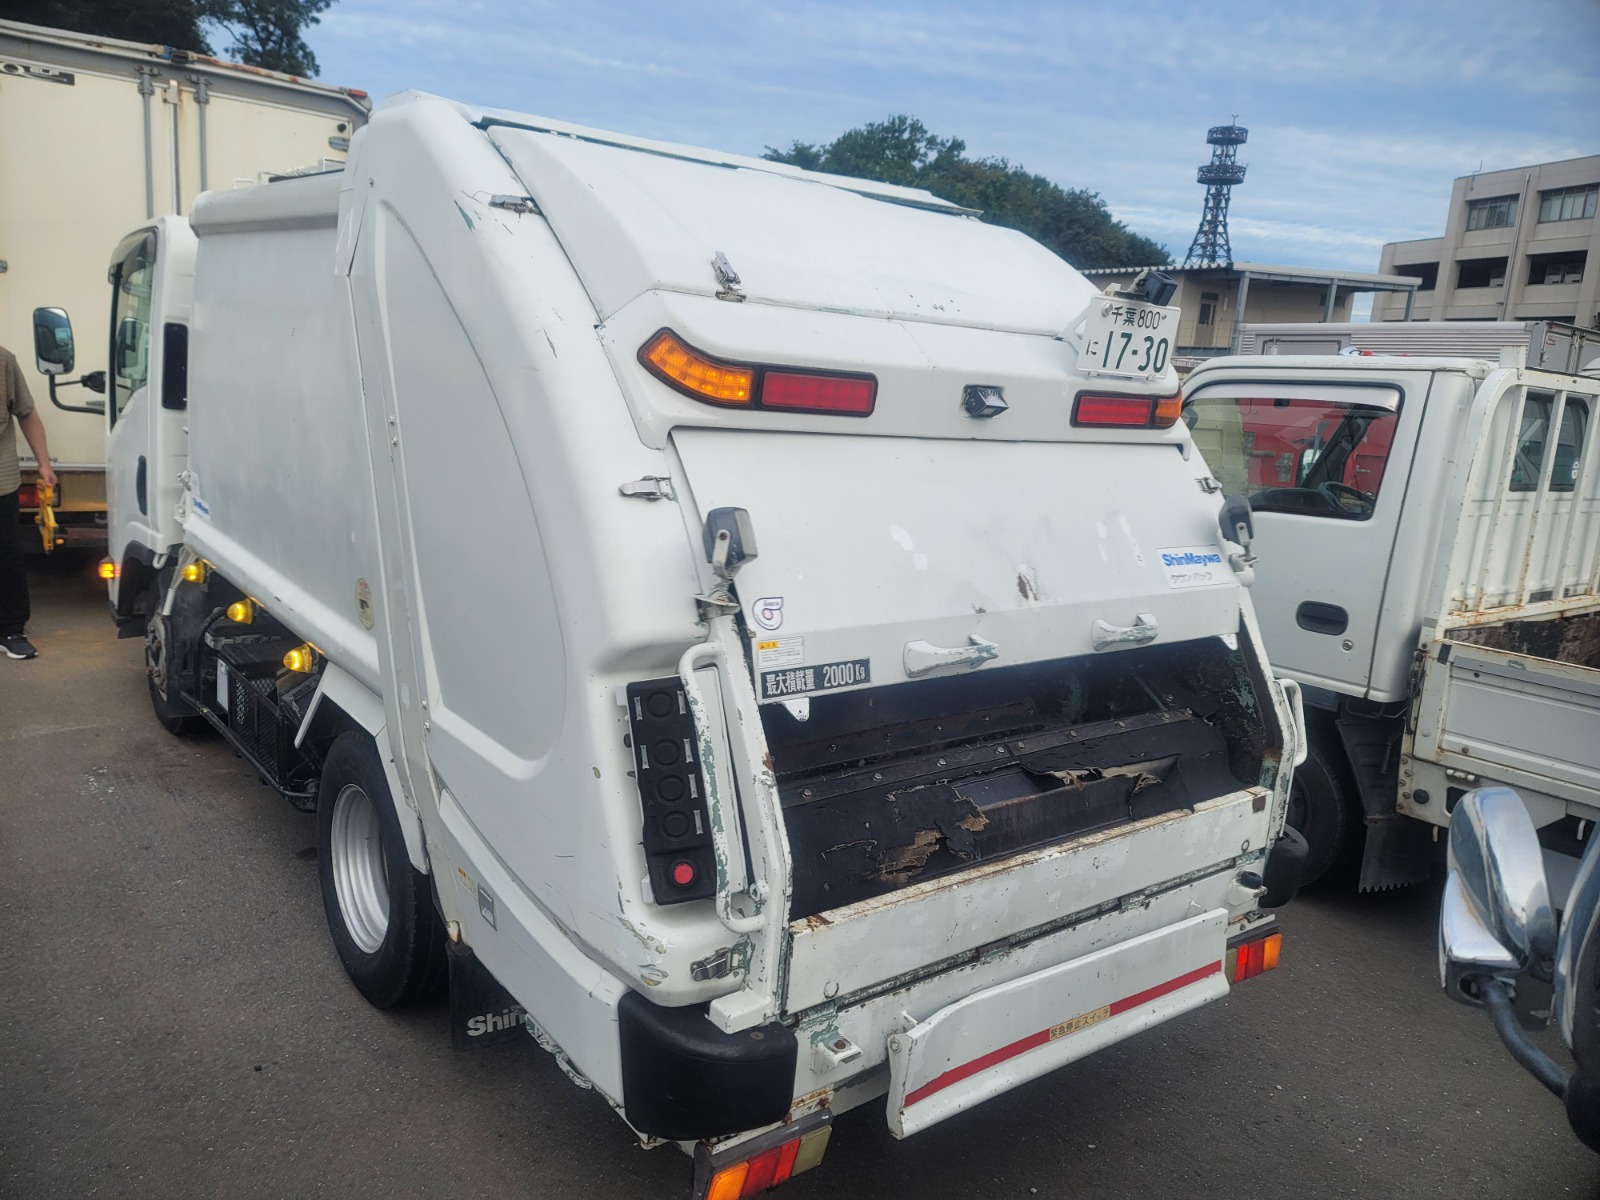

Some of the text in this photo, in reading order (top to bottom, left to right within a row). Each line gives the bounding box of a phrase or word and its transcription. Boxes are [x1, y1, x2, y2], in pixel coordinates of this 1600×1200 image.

[1086, 330, 1169, 373] に 17-30
[1162, 552, 1222, 567] ShinMaywa
[766, 669, 816, 695] 最大積載量
[1050, 1007, 1110, 1039] 緊急停止スイッチ
